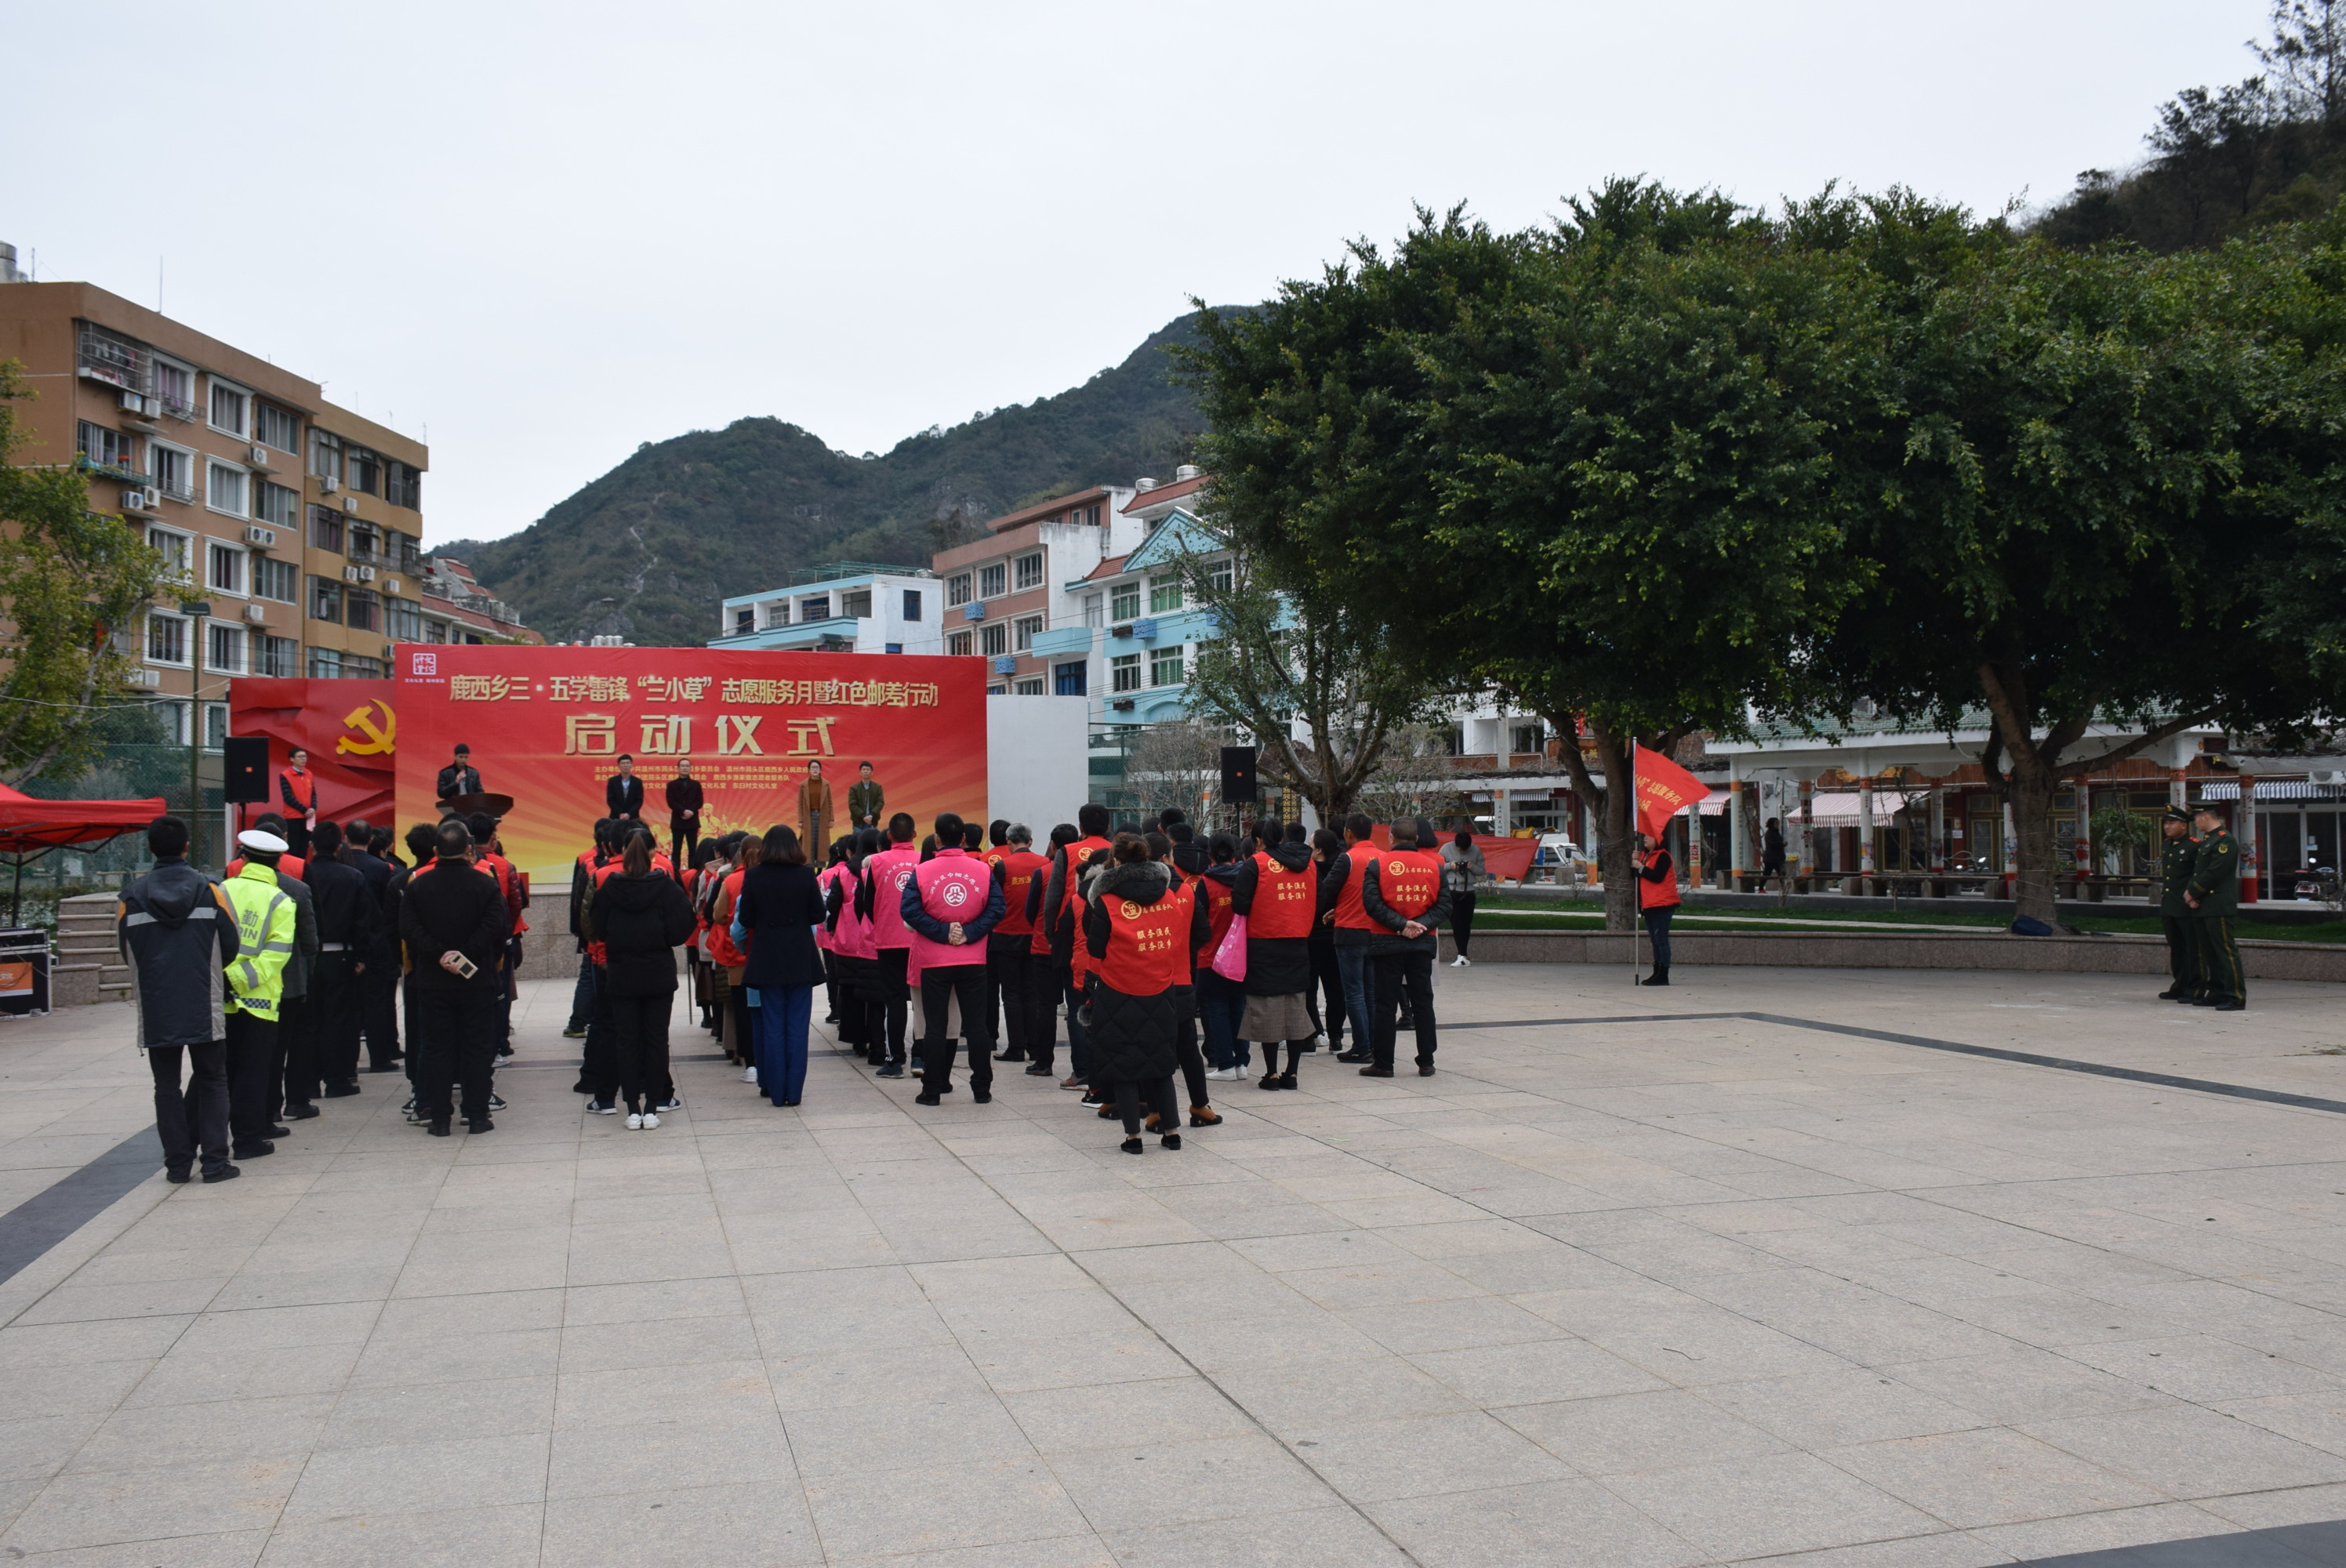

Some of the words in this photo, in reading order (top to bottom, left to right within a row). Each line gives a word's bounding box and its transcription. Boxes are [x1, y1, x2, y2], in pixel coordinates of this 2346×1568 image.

[721, 677, 939, 707] 志愿服务月暨红色邮差行动
[564, 713, 836, 755] 启动仪式
[242, 909, 259, 927] 勤
